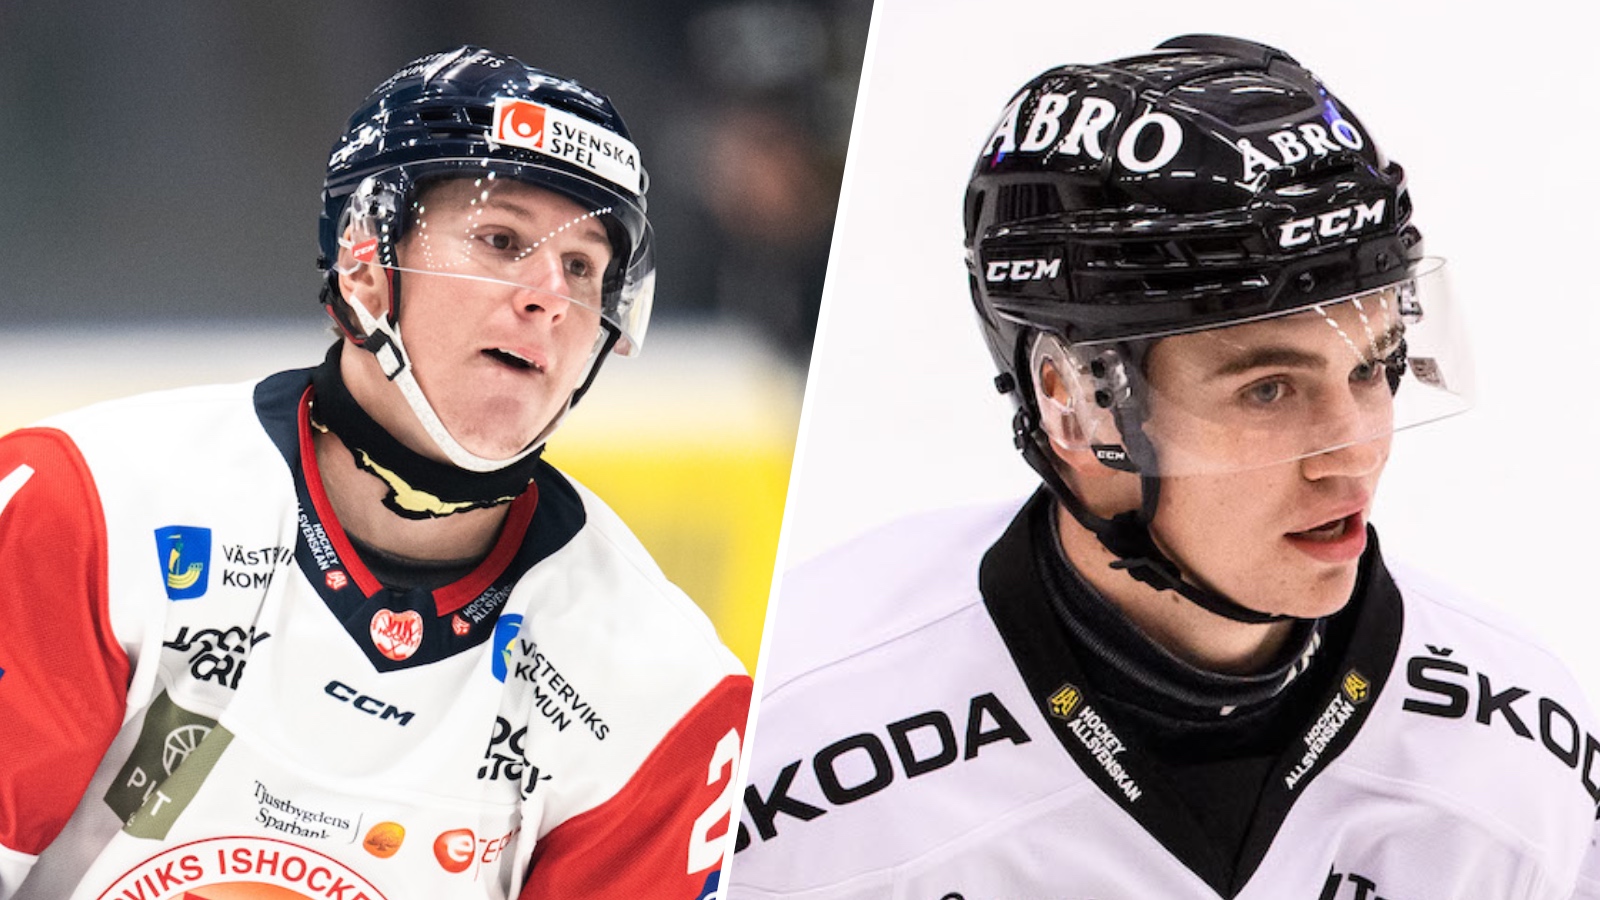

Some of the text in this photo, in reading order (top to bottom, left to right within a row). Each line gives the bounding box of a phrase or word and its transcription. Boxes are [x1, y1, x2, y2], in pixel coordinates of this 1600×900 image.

[550, 138, 597, 170] SPEL
[552, 121, 636, 171] SVENSKA
[1236, 119, 1364, 182] ÅBRO
[1278, 200, 1386, 248] CCM
[986, 258, 1061, 282] CCM
[1096, 450, 1125, 460] CCM
[312, 523, 340, 566] HOCKEY
[463, 586, 497, 618] HOCKEY
[323, 680, 416, 726] CCM
[1304, 692, 1343, 746] HOCKEY
[1078, 705, 1127, 755] HOCKEY
[1284, 700, 1356, 790] ALLSVENSKAN
[1067, 718, 1142, 802] ALLSVENSKAN
[254, 779, 351, 829] Tjustbygdens
[114, 855, 204, 900] VIKS
